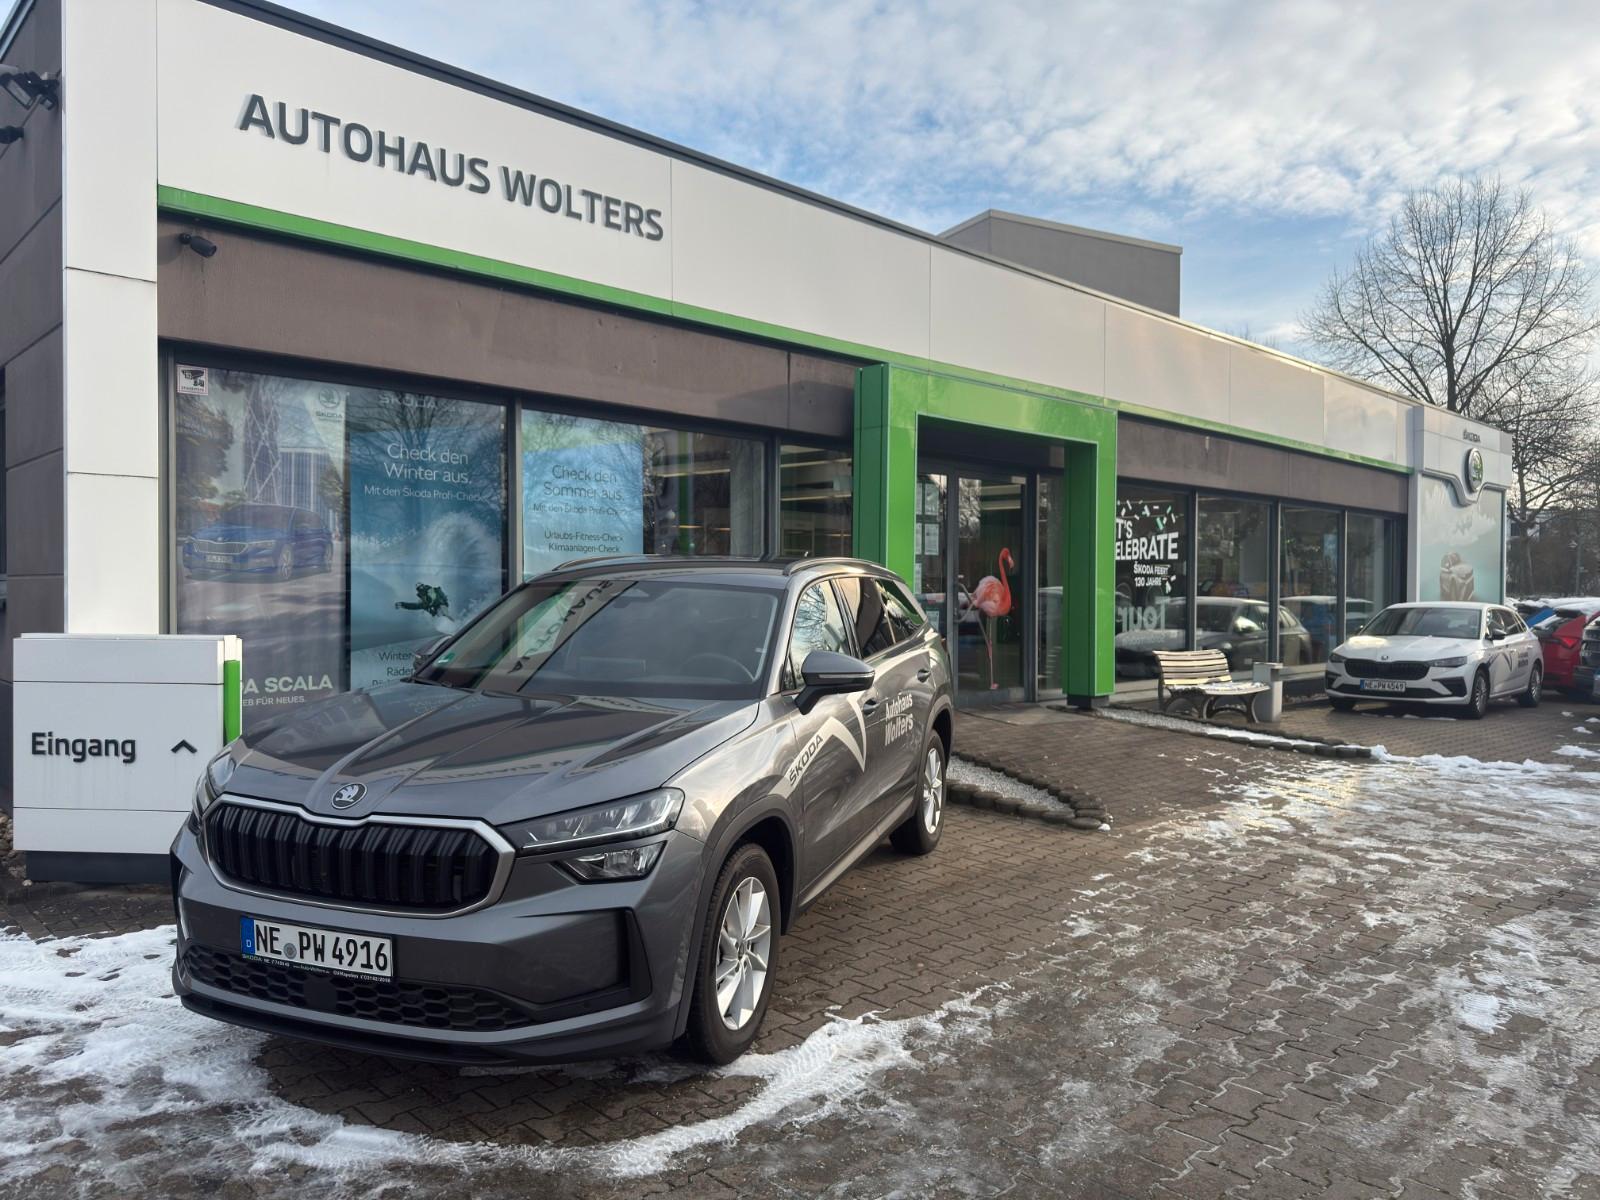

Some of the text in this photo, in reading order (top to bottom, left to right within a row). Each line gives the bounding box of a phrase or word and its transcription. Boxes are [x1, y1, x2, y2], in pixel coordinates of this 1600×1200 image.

[239, 94, 664, 241] AUTOHAUS WOLTERS
[387, 443, 469, 464] Check den
[384, 462, 472, 484] Winter aus.
[552, 465, 617, 484] Check den
[364, 485, 380, 496] Mit
[383, 486, 400, 496] den
[543, 482, 625, 501] Sommer aus.
[1116, 518, 1133, 539] T'S
[1116, 532, 1179, 560] ELEBRATE
[1134, 577, 1162, 587] 130 JAHRE
[264, 674, 334, 693] SCALA
[255, 695, 274, 705] FÜR
[275, 695, 305, 704] NEUES
[885, 693, 913, 719] Autohaus
[885, 714, 914, 746] Wolters
[31, 731, 136, 764] Eingang
[789, 734, 823, 787] ŠKODA
[255, 923, 282, 956] NE
[297, 931, 326, 963] PW
[331, 936, 389, 972] 4916
